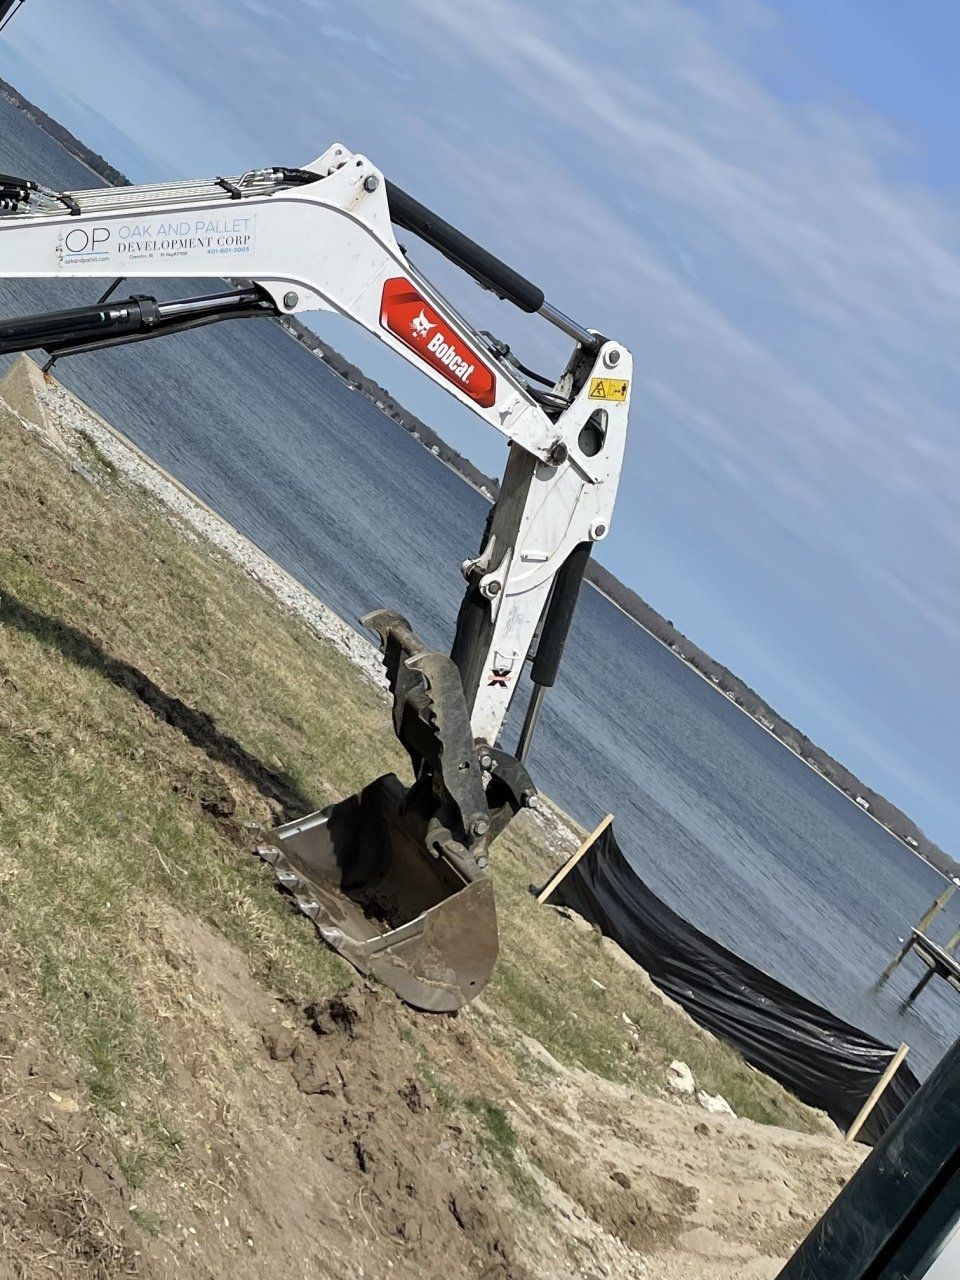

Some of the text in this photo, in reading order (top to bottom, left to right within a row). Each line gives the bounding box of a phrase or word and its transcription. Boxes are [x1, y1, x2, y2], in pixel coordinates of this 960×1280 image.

[65, 227, 111, 253] OP
[118, 218, 251, 240] OAK AND PALLET
[117, 235, 251, 253] DEVELOPMENT CORP
[426, 332, 475, 382] Bobcat
